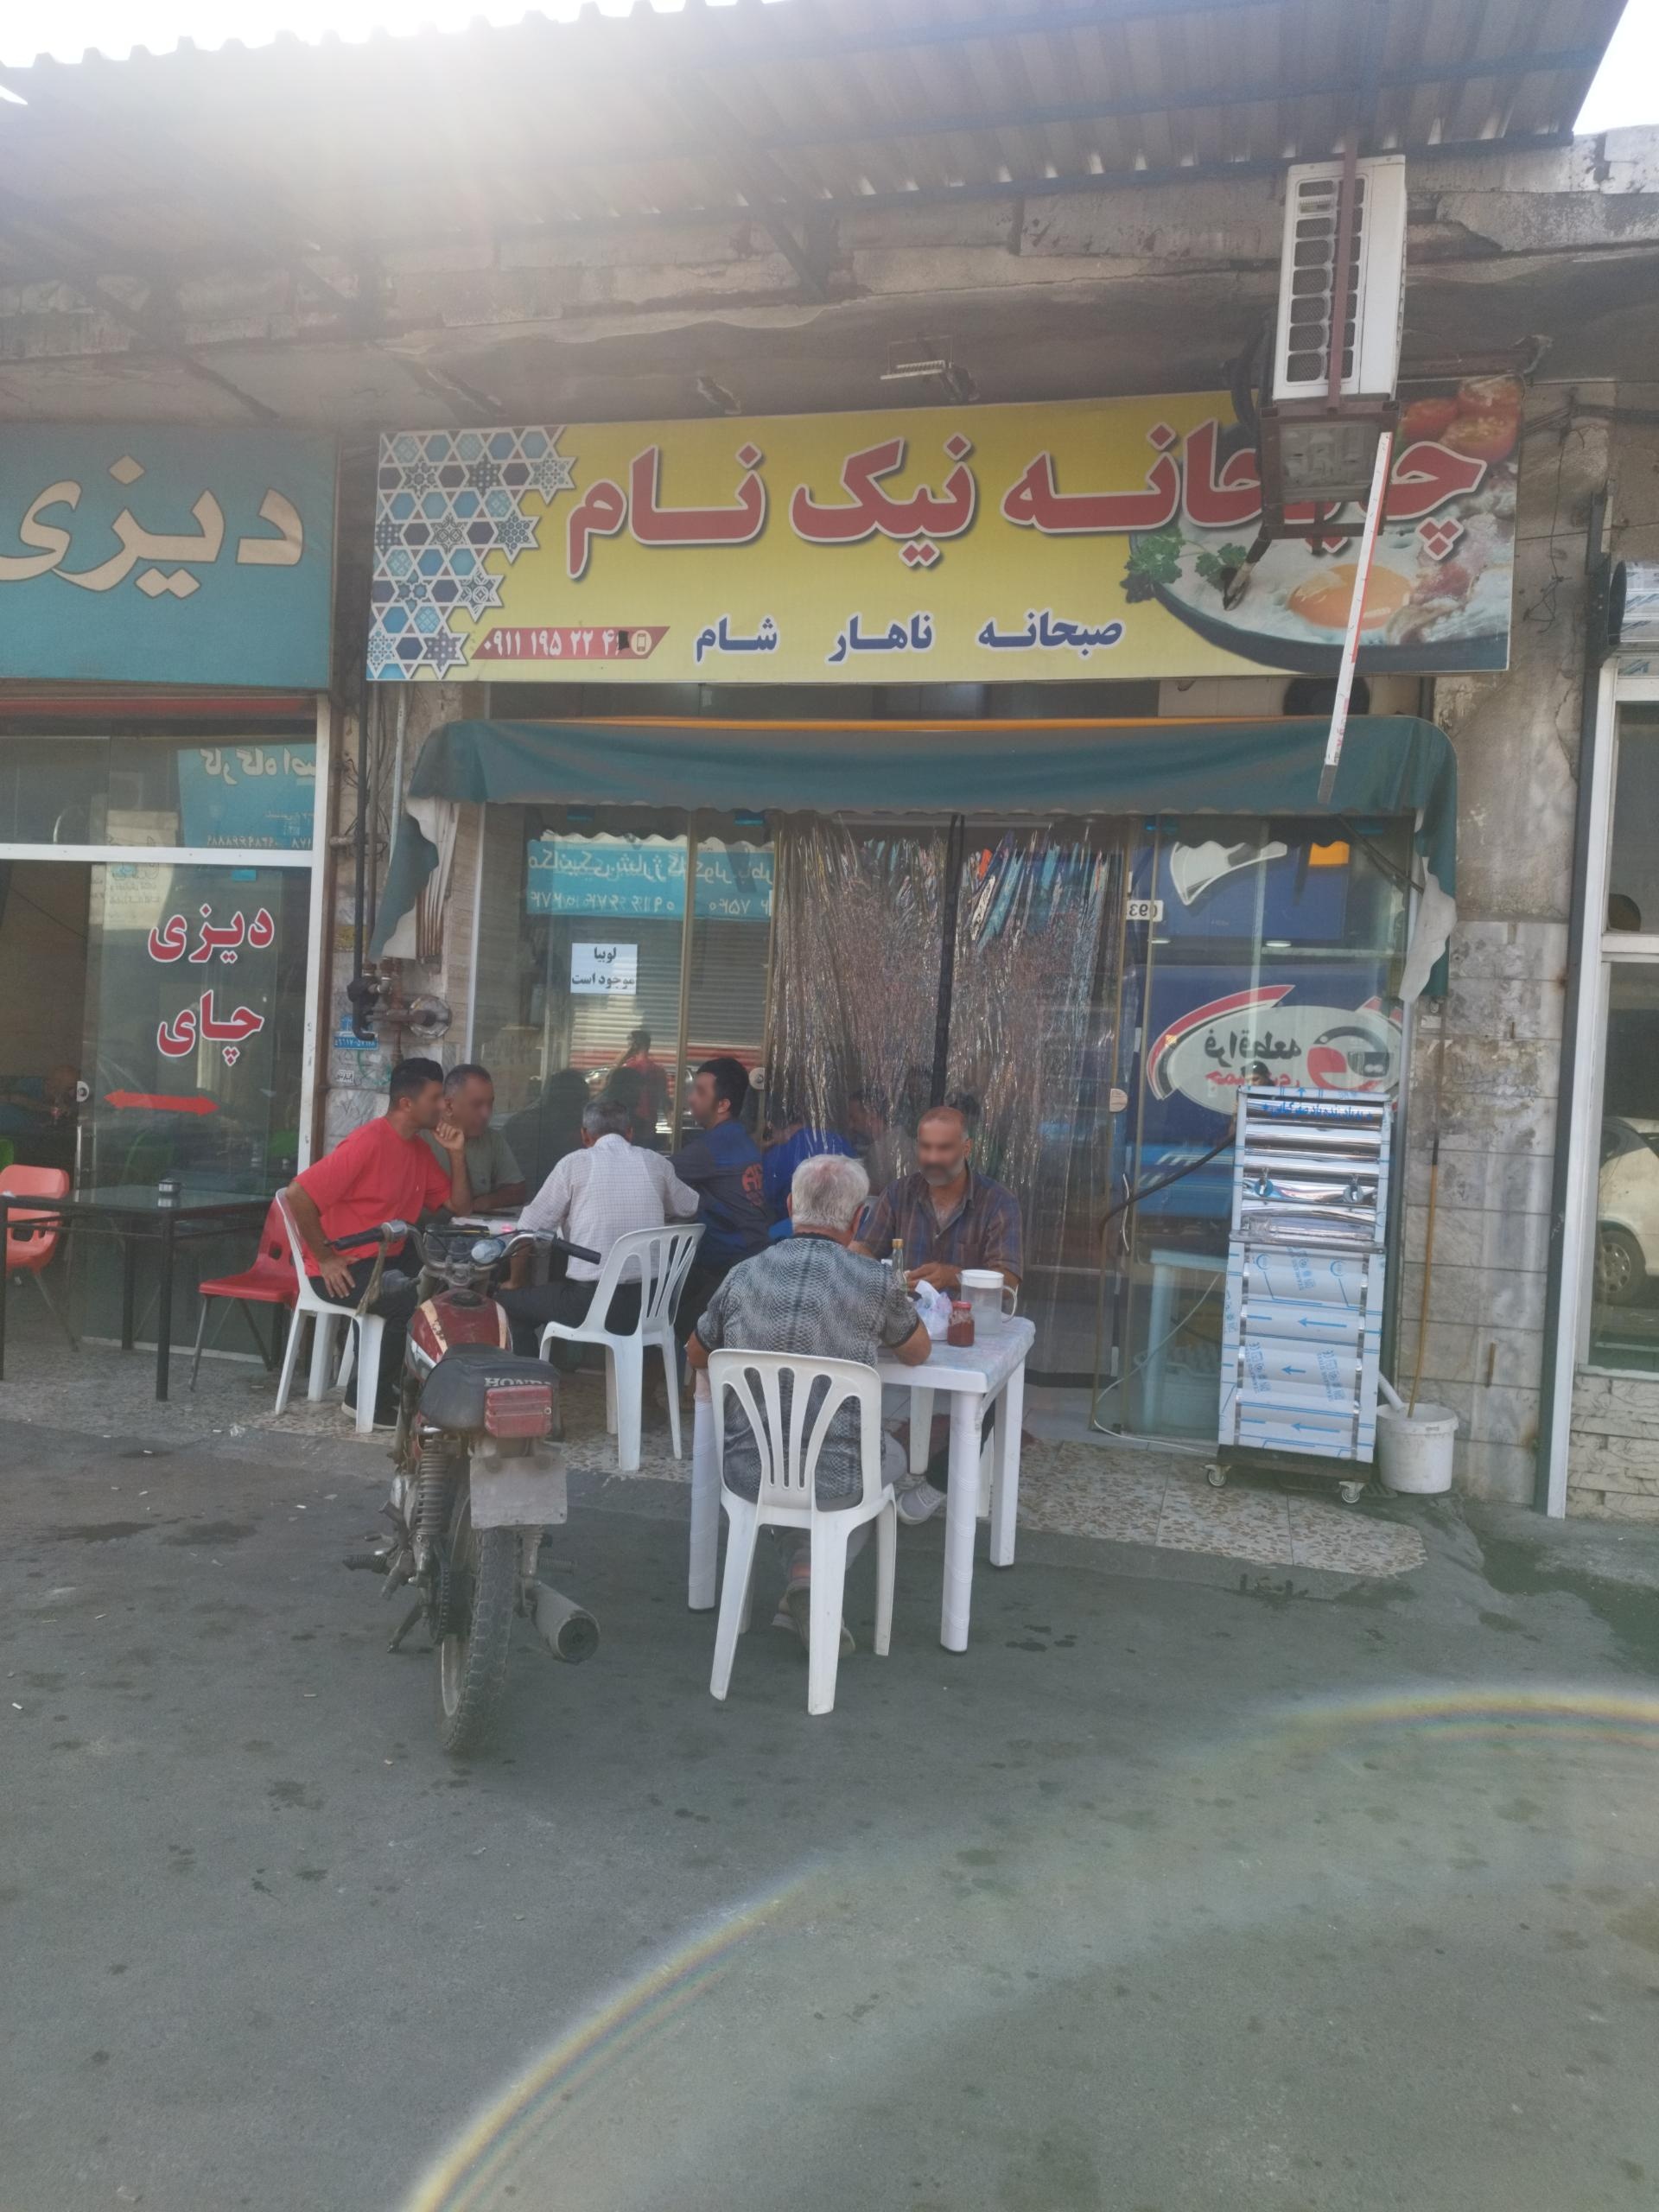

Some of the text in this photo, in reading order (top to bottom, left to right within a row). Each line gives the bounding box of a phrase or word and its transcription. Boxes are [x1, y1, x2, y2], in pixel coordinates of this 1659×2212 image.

[0, 455, 304, 599] دیزی
[566, 417, 1487, 579] چیخانه نیک نام
[602, 628, 629, 657] ۴
[694, 607, 1125, 665] صبحانه ناهار شام
[148, 903, 275, 963] دیزی
[594, 946, 617, 963] لوبیا
[572, 973, 635, 990] موجود است
[156, 990, 264, 1066] چای
[484, 1377, 551, 1387] HON
